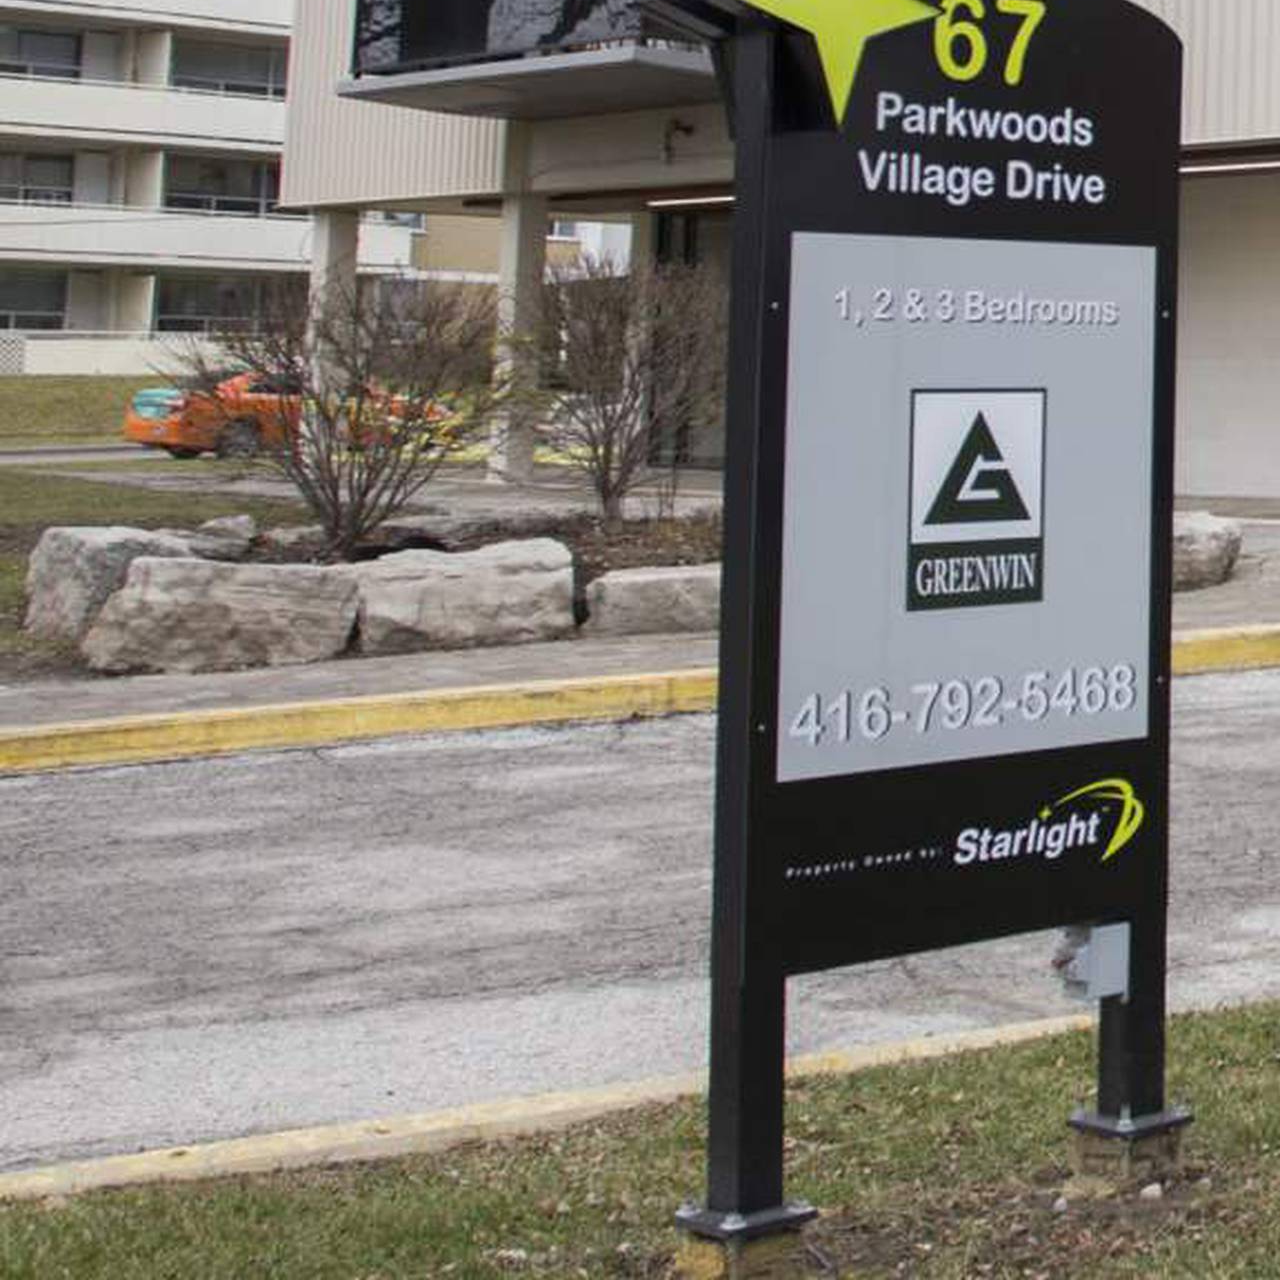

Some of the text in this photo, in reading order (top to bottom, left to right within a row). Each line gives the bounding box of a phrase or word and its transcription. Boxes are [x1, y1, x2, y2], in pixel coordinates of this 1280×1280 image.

[875, 91, 1095, 147] Parkwoods
[857, 149, 1107, 206] Village Drive
[833, 287, 1120, 328] 1, 2 & 3 Bedrooms
[915, 552, 1037, 598] GREENWIN
[788, 663, 1138, 746] 416-792-5468
[952, 809, 1102, 865] Starlight
